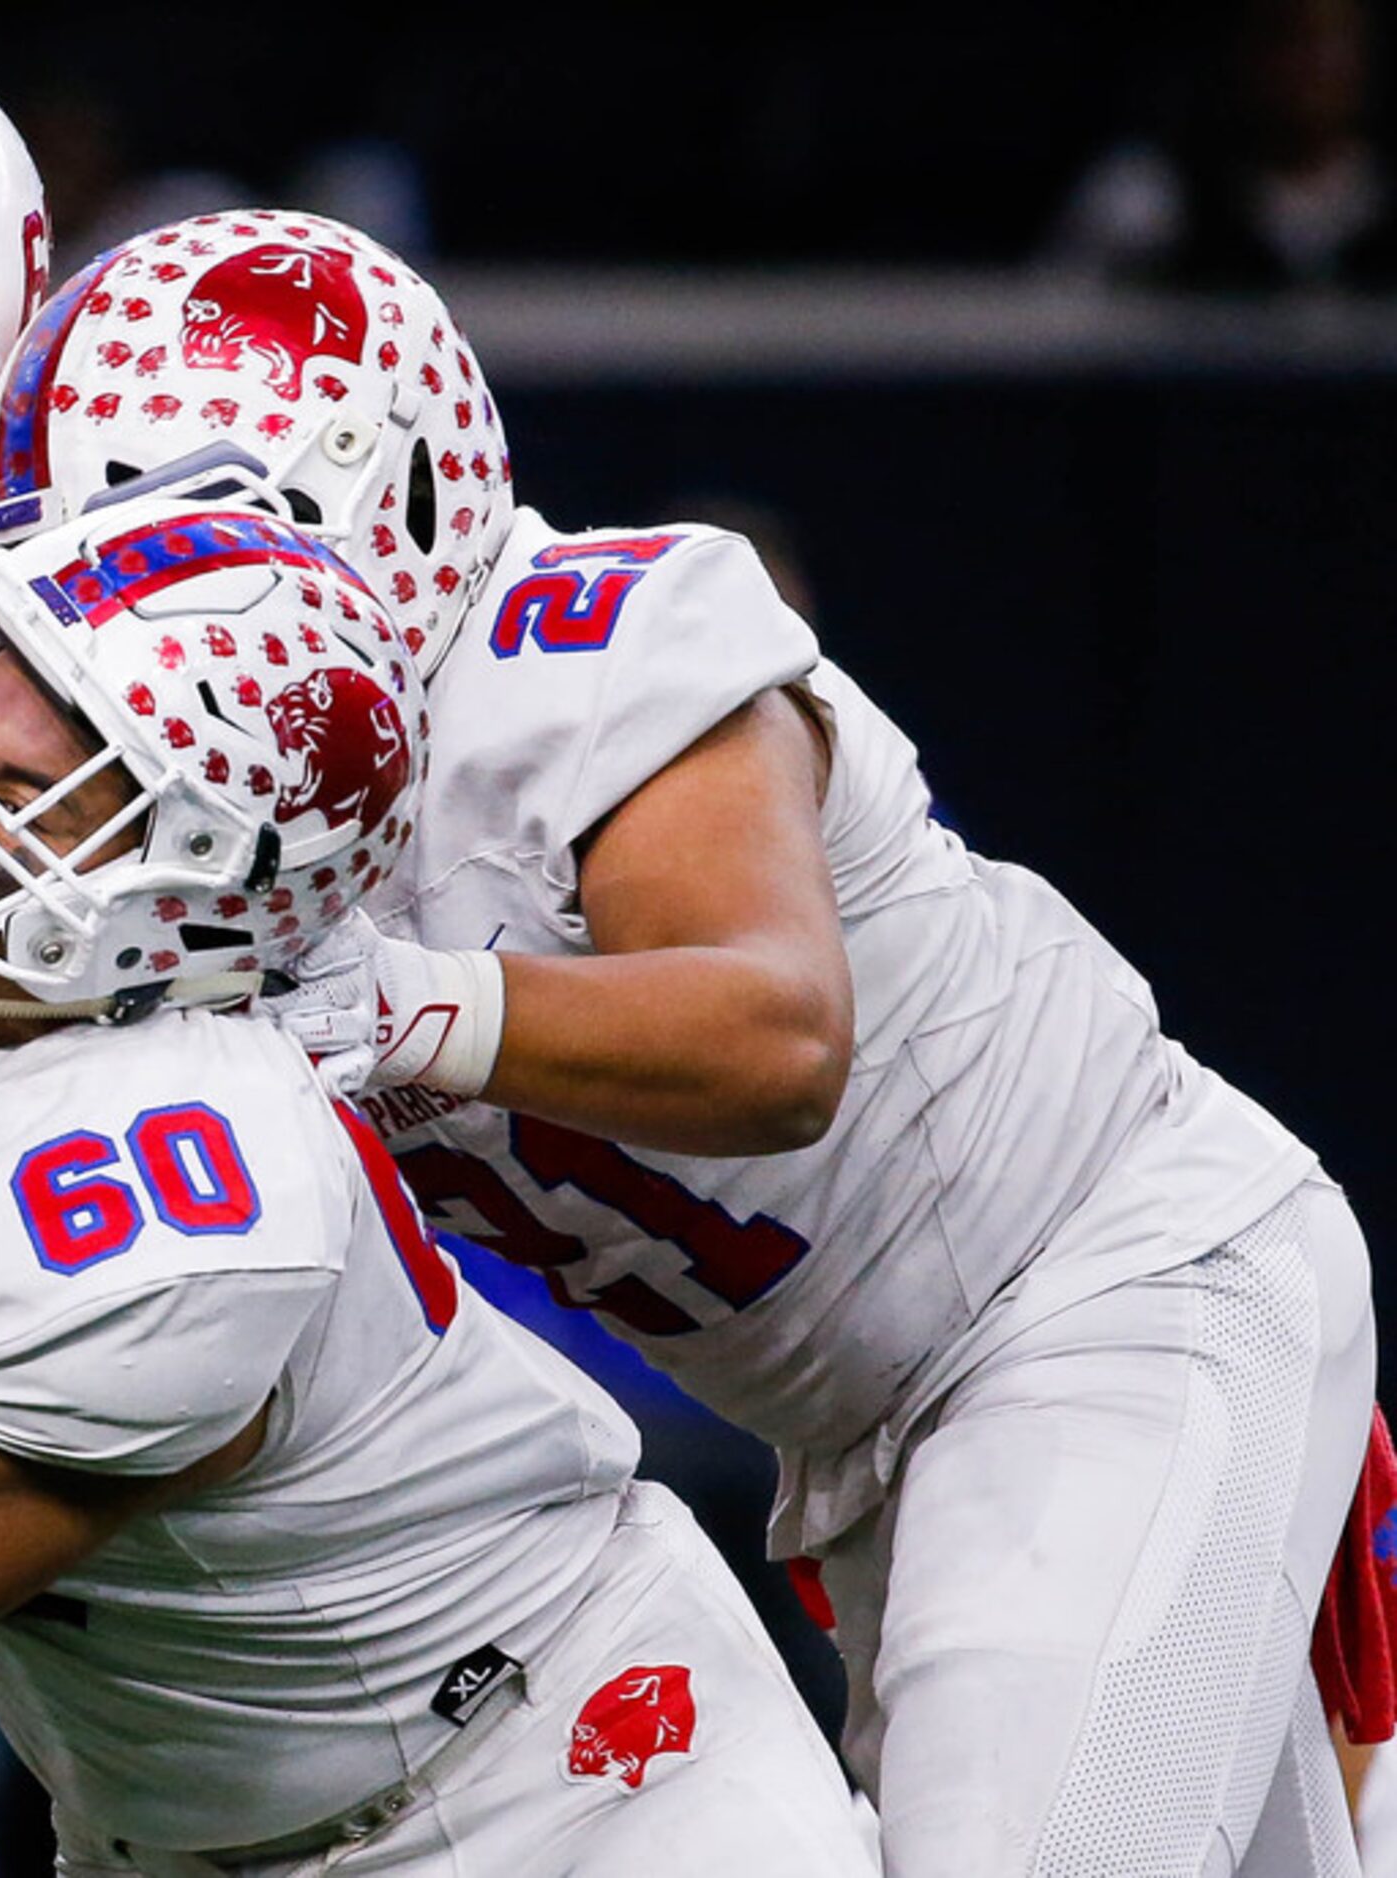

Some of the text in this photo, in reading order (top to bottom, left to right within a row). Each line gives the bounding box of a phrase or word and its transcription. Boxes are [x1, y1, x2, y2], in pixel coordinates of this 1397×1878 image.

[489, 535, 689, 660] 21
[10, 1101, 262, 1277] 60
[448, 1666, 492, 1701] XL
